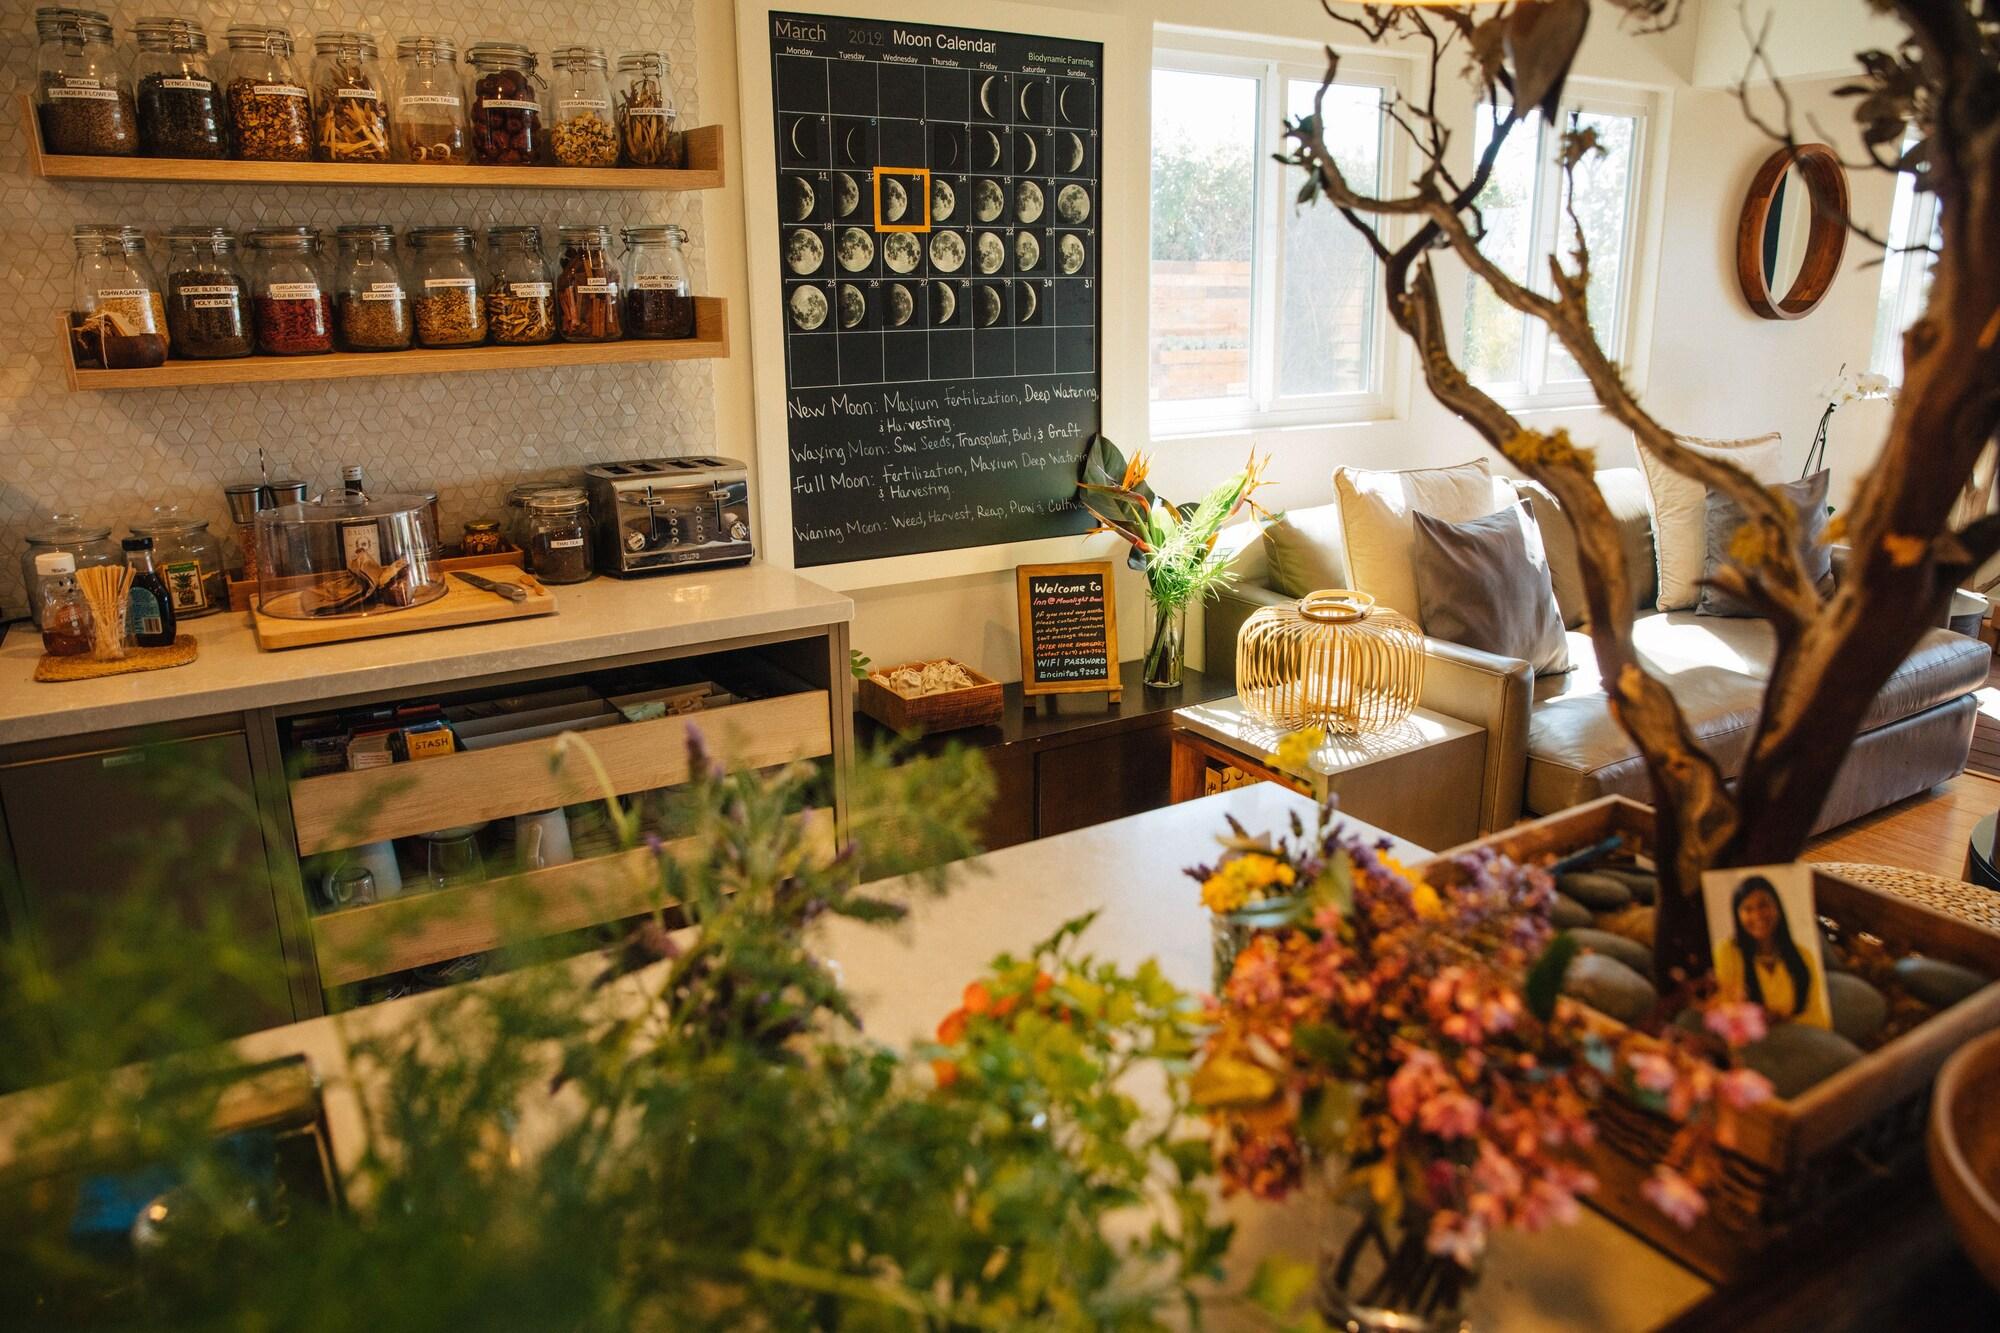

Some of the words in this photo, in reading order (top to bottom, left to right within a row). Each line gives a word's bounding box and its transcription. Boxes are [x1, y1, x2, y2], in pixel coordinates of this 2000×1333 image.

[775, 20, 826, 41] March
[849, 31, 882, 45] 2019
[893, 29, 932, 48] Moon
[936, 34, 996, 54] Calendar
[786, 46, 813, 56] Monday
[839, 51, 865, 61] Tuesday
[883, 53, 918, 64] Wednesday
[931, 57, 959, 67] Thursday
[980, 62, 998, 71] Friday
[1022, 65, 1046, 74] Saturday
[1067, 69, 1086, 77] Sunday
[1028, 52, 1067, 65] Biodynamic
[1067, 56, 1094, 67] Farming
[66, 79, 99, 87] ORGANIC
[49, 89, 83, 97] AVENDER
[959, 175, 967, 183] 14
[1004, 176, 1011, 184] 15
[1087, 228, 1095, 236] 24
[828, 279, 836, 287] 25
[871, 279, 879, 287] 26
[920, 278, 928, 286] 27
[1044, 279, 1052, 287] 30
[1084, 280, 1092, 288] 31
[788, 396, 826, 418] New
[831, 393, 879, 415] Moon:
[944, 386, 1022, 406] Fertilization,
[1025, 384, 1050, 403] Deep
[1052, 383, 1099, 402] Watering,
[791, 443, 846, 466] Waxing
[848, 439, 890, 459] Moon:
[894, 436, 917, 453] Sow
[921, 435, 954, 452] Seeds,
[955, 428, 1011, 449] Transplant,
[1012, 426, 1036, 443] Bud,
[793, 473, 825, 494] Full
[831, 472, 875, 490] Moon:
[883, 461, 967, 484] Fertilization,
[1021, 452, 1046, 470] Deep
[1049, 450, 1088, 466] Waterin
[794, 523, 844, 543] Waning
[846, 520, 888, 535] Moon:
[891, 511, 926, 528] Weed,
[928, 505, 974, 524] Harvest,
[977, 505, 1007, 519] Reap,
[1009, 500, 1035, 514] Plow
[1034, 583, 1086, 594] Welcome
[1089, 581, 1102, 591] to
[1033, 597, 1047, 606] Inn
[1037, 658, 1060, 667] WIFI
[1064, 657, 1106, 666] PASSWORD
[415, 738, 449, 750] STASH
